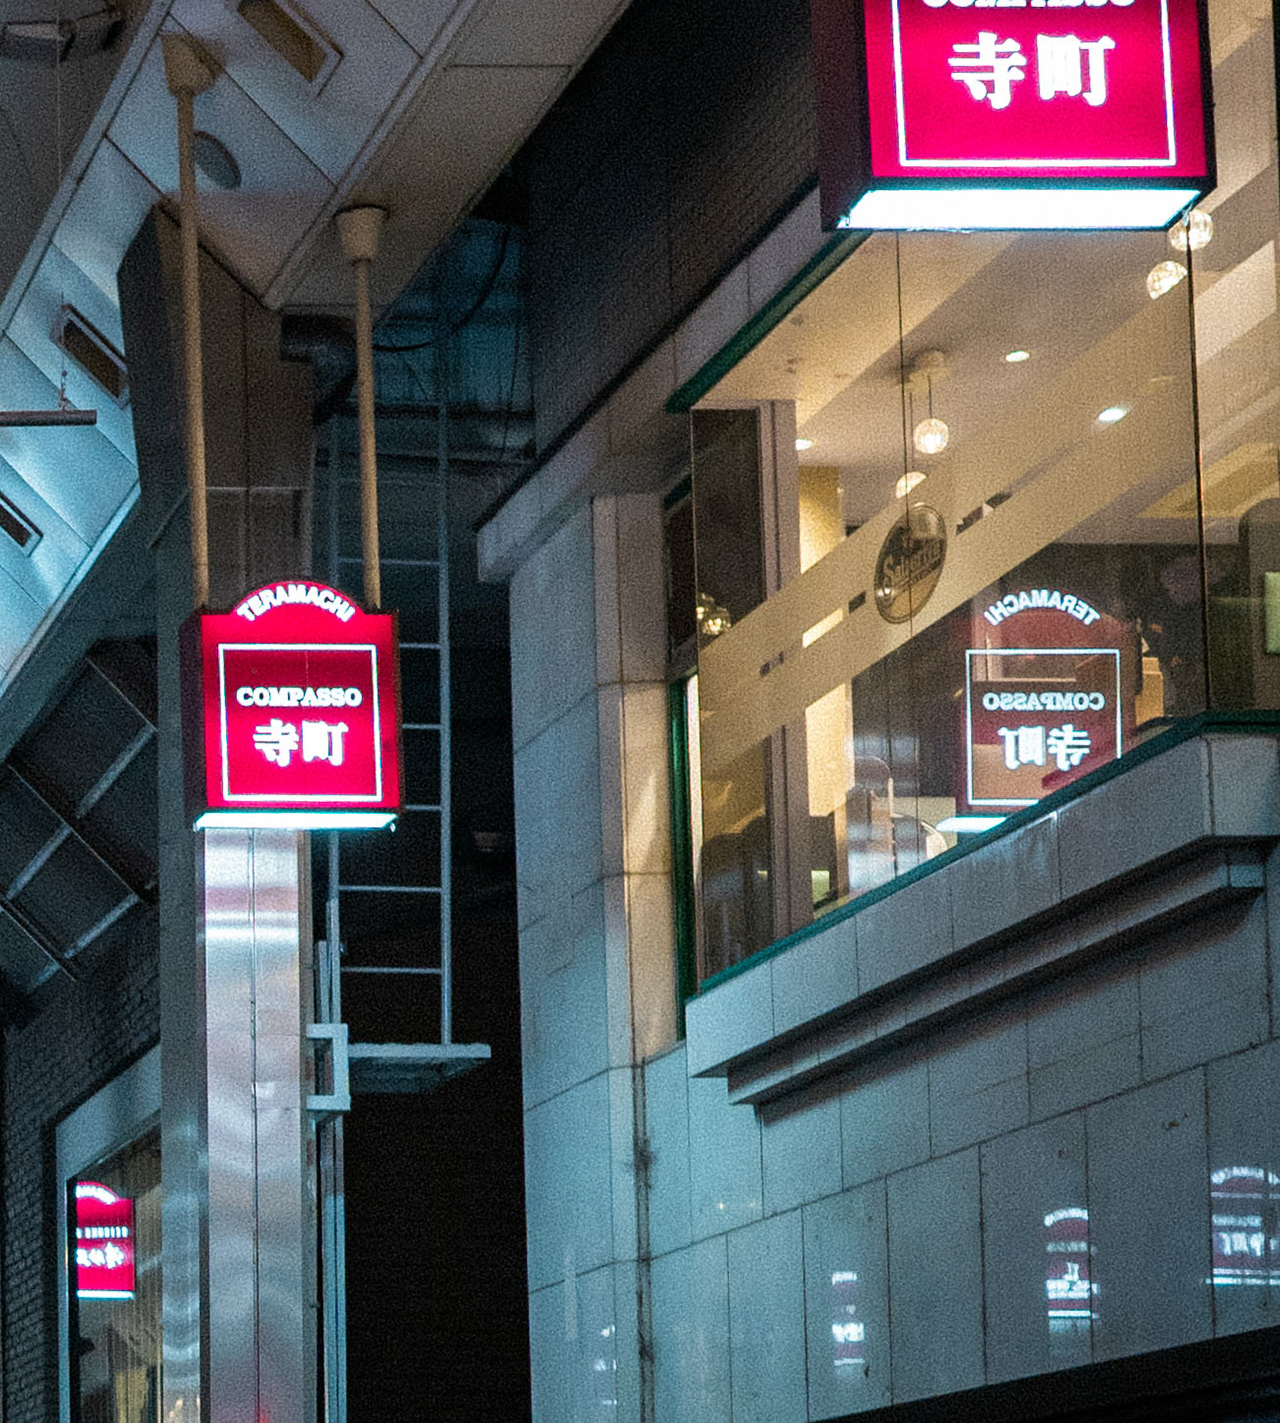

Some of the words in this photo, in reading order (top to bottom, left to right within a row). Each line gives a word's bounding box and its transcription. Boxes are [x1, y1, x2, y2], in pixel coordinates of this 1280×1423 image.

[947, 31, 1116, 109] 寺町
[236, 583, 356, 622] TERAMACHI
[236, 686, 363, 707] COMPASSO
[252, 718, 349, 767] 寺町
